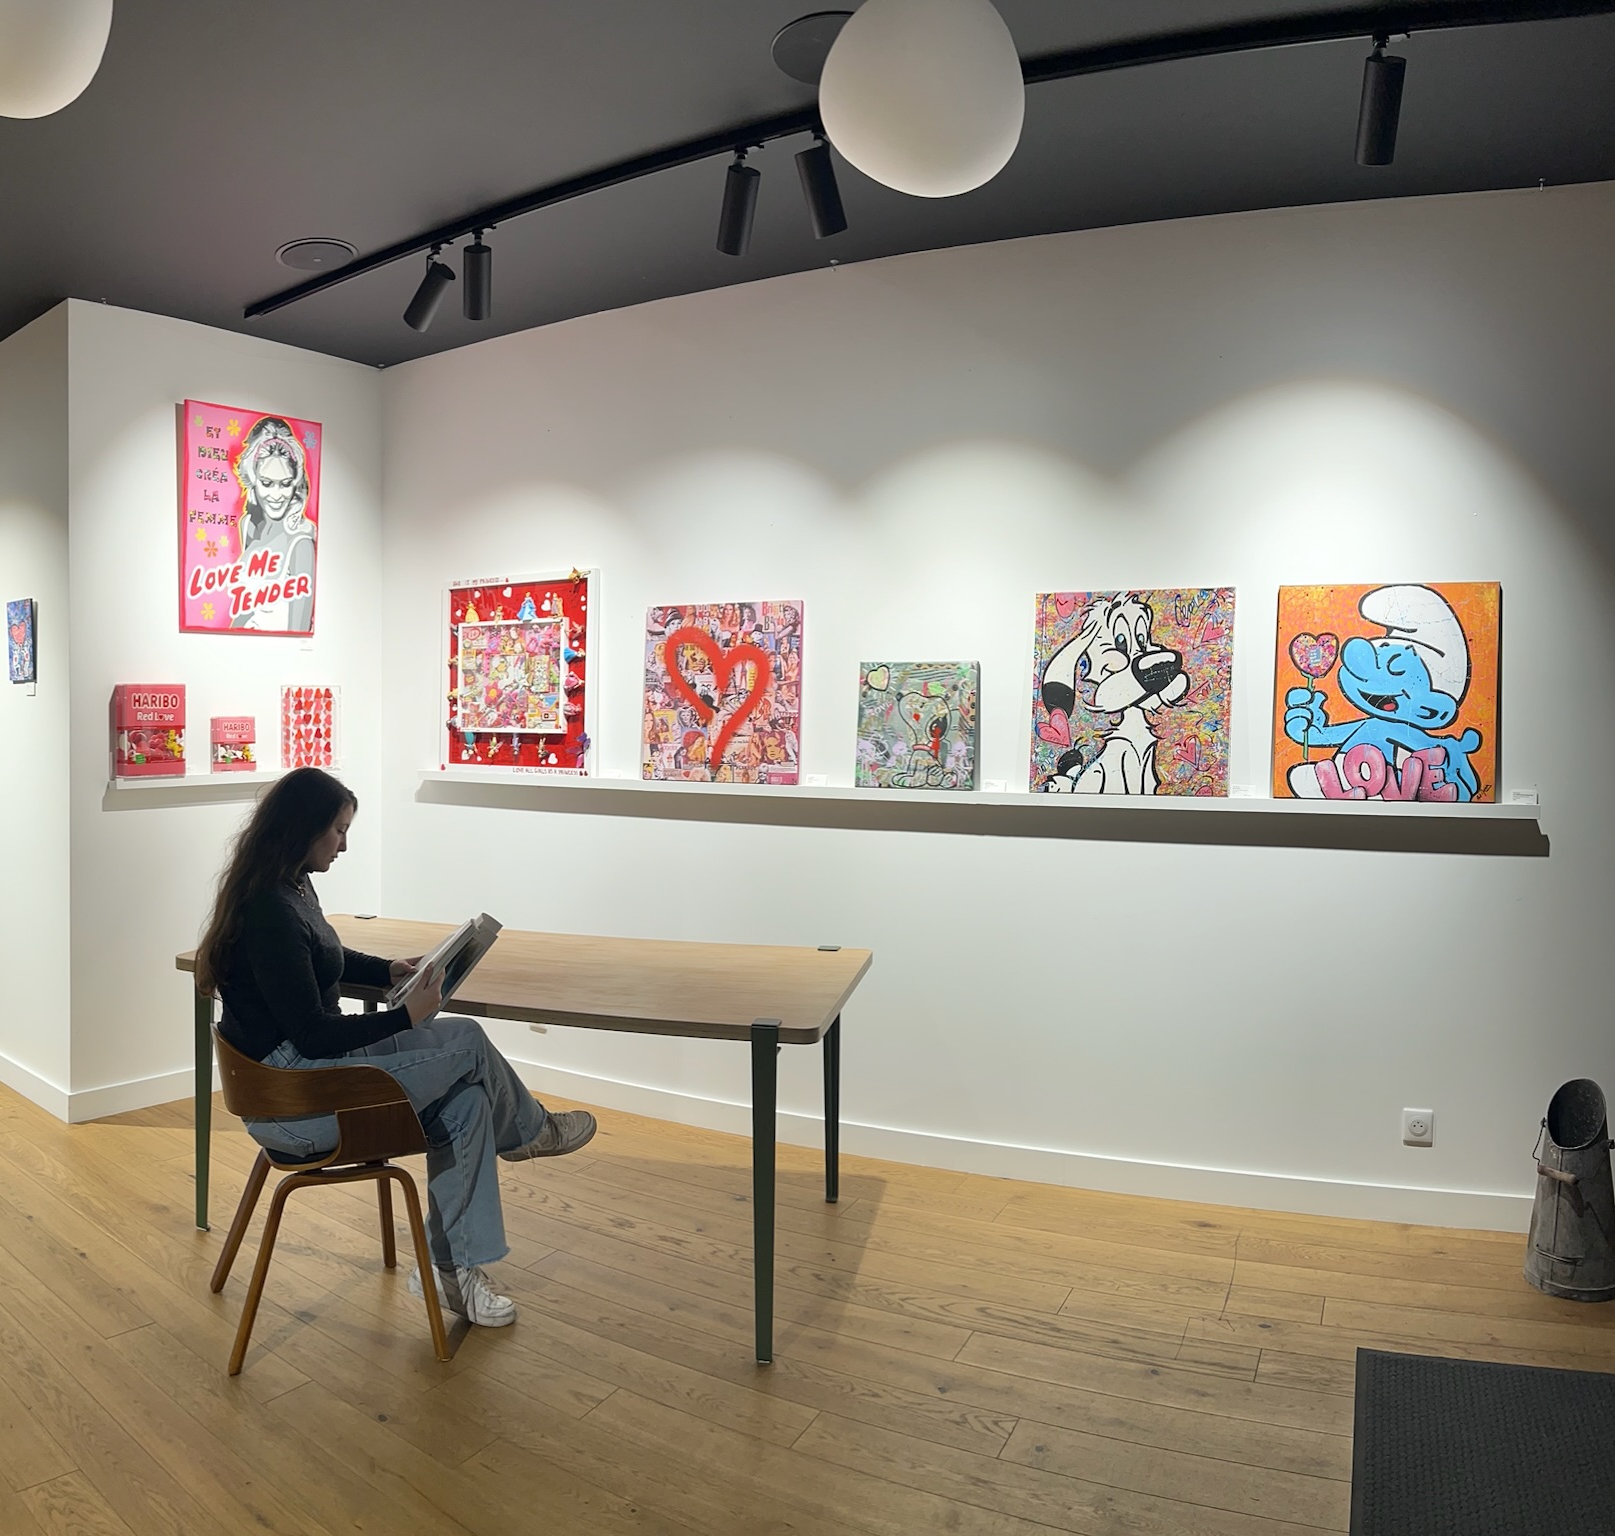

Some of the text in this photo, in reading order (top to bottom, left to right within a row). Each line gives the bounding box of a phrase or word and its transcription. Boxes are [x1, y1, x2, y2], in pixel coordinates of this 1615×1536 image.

[204, 489, 220, 503] LA
[189, 510, 237, 527] FEMME
[189, 549, 281, 597] LOVE ME
[230, 575, 309, 616] TENDER
[132, 693, 179, 709] HARIBO
[137, 711, 153, 721] Red
[223, 722, 250, 732] HARIBO
[1314, 743, 1459, 802] LOVE
